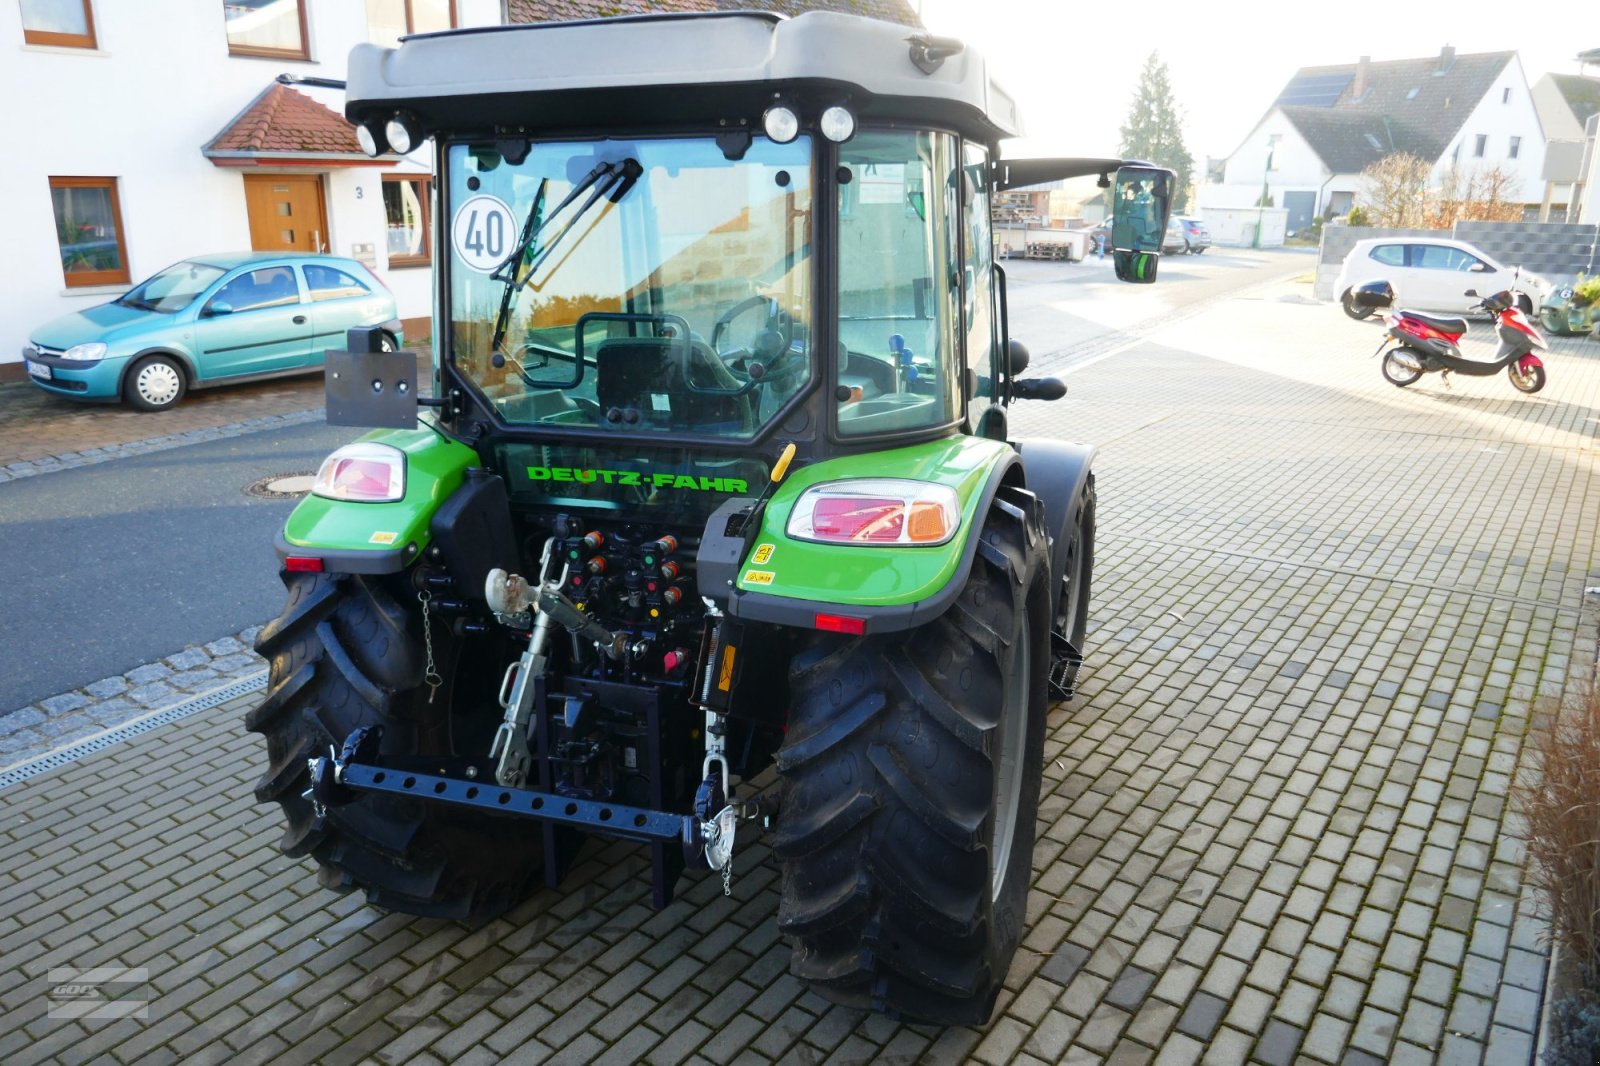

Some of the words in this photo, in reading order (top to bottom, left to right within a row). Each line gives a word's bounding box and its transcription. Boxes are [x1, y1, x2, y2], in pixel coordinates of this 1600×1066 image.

[355, 186, 363, 199] 3
[465, 210, 503, 257] 40
[527, 466, 748, 494] DEUTZ-FAHR
